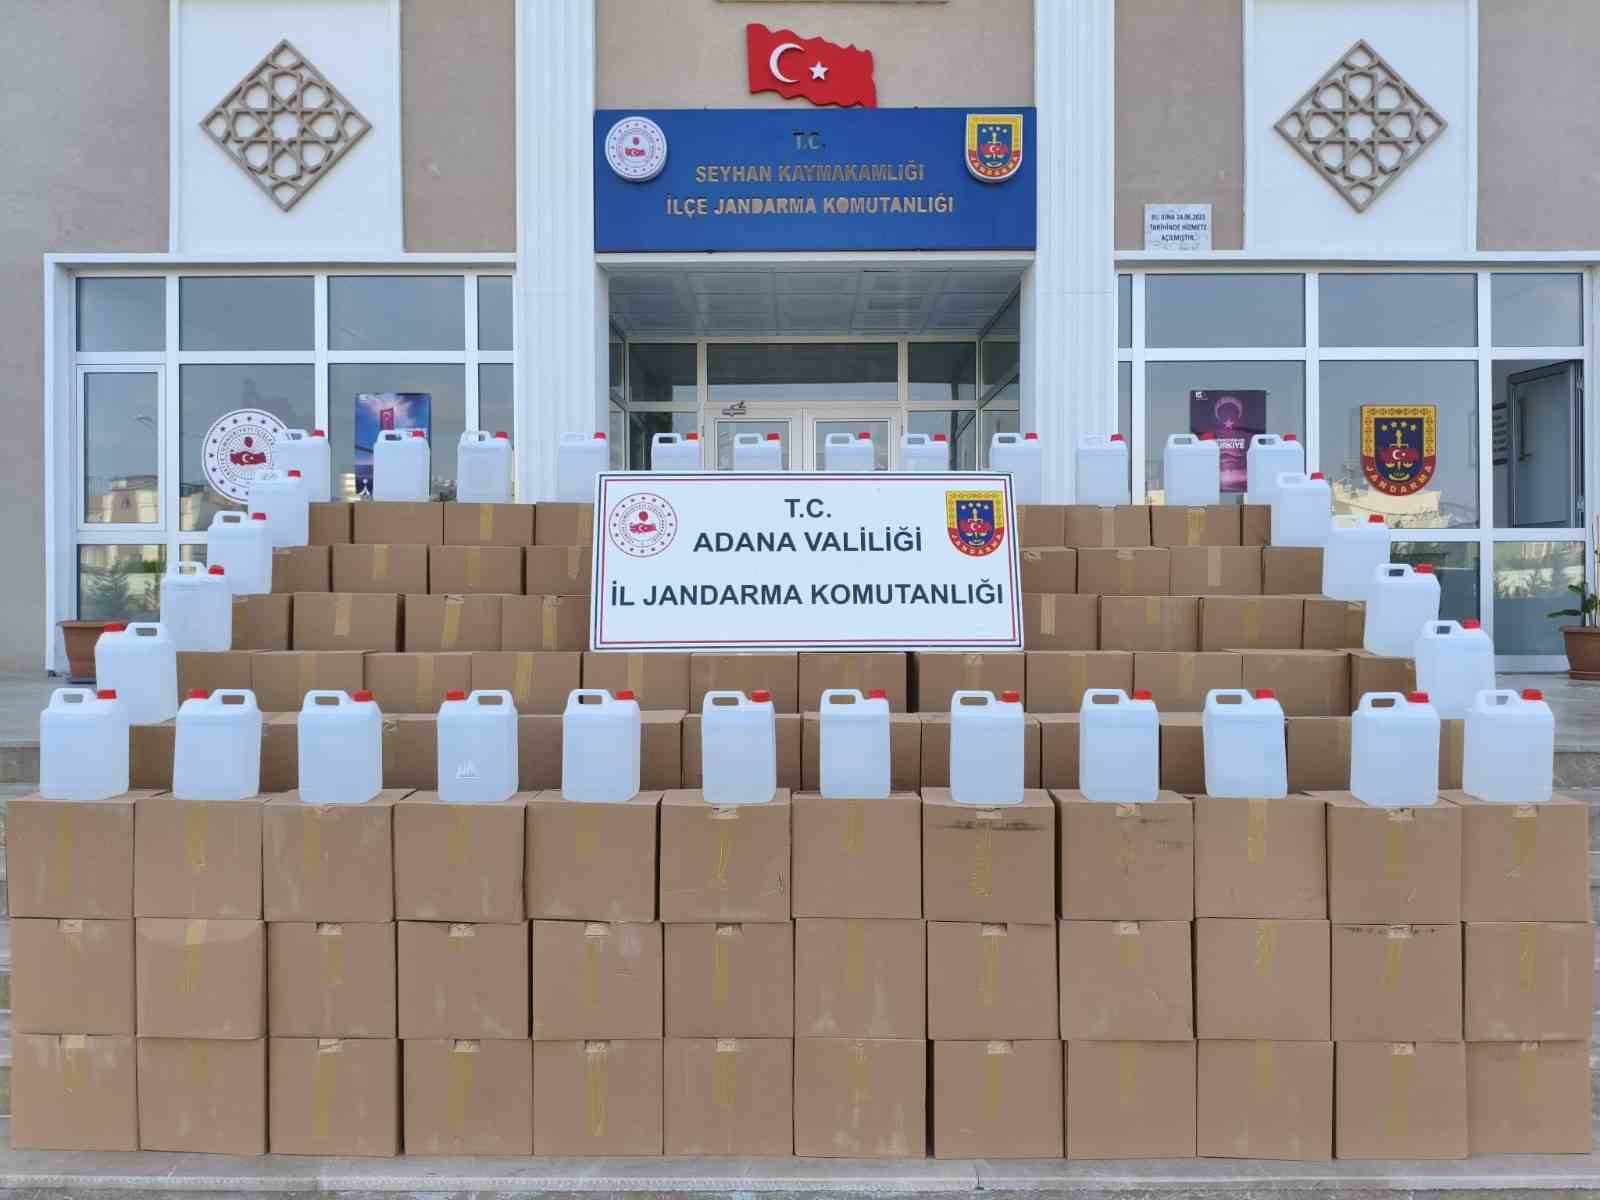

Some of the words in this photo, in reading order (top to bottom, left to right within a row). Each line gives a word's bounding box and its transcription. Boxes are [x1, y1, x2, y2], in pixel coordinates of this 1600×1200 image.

[792, 132, 826, 150] T.C.
[695, 165, 772, 183] SEYHAN
[779, 160, 925, 182] KAYMAKAMLIĞI
[666, 193, 709, 219] İLÇE
[713, 197, 817, 215] JANDARMA
[823, 193, 954, 214] KOMUTANLIĞI
[1365, 465, 1433, 493] JANDARMA
[784, 498, 831, 518] T.C.
[693, 532, 797, 552] ADANA
[804, 526, 922, 552] VALİLİĞİ
[611, 580, 635, 606] İL
[642, 584, 804, 606] JANDARMA
[811, 578, 1003, 605] KOMUTANLIĞI
